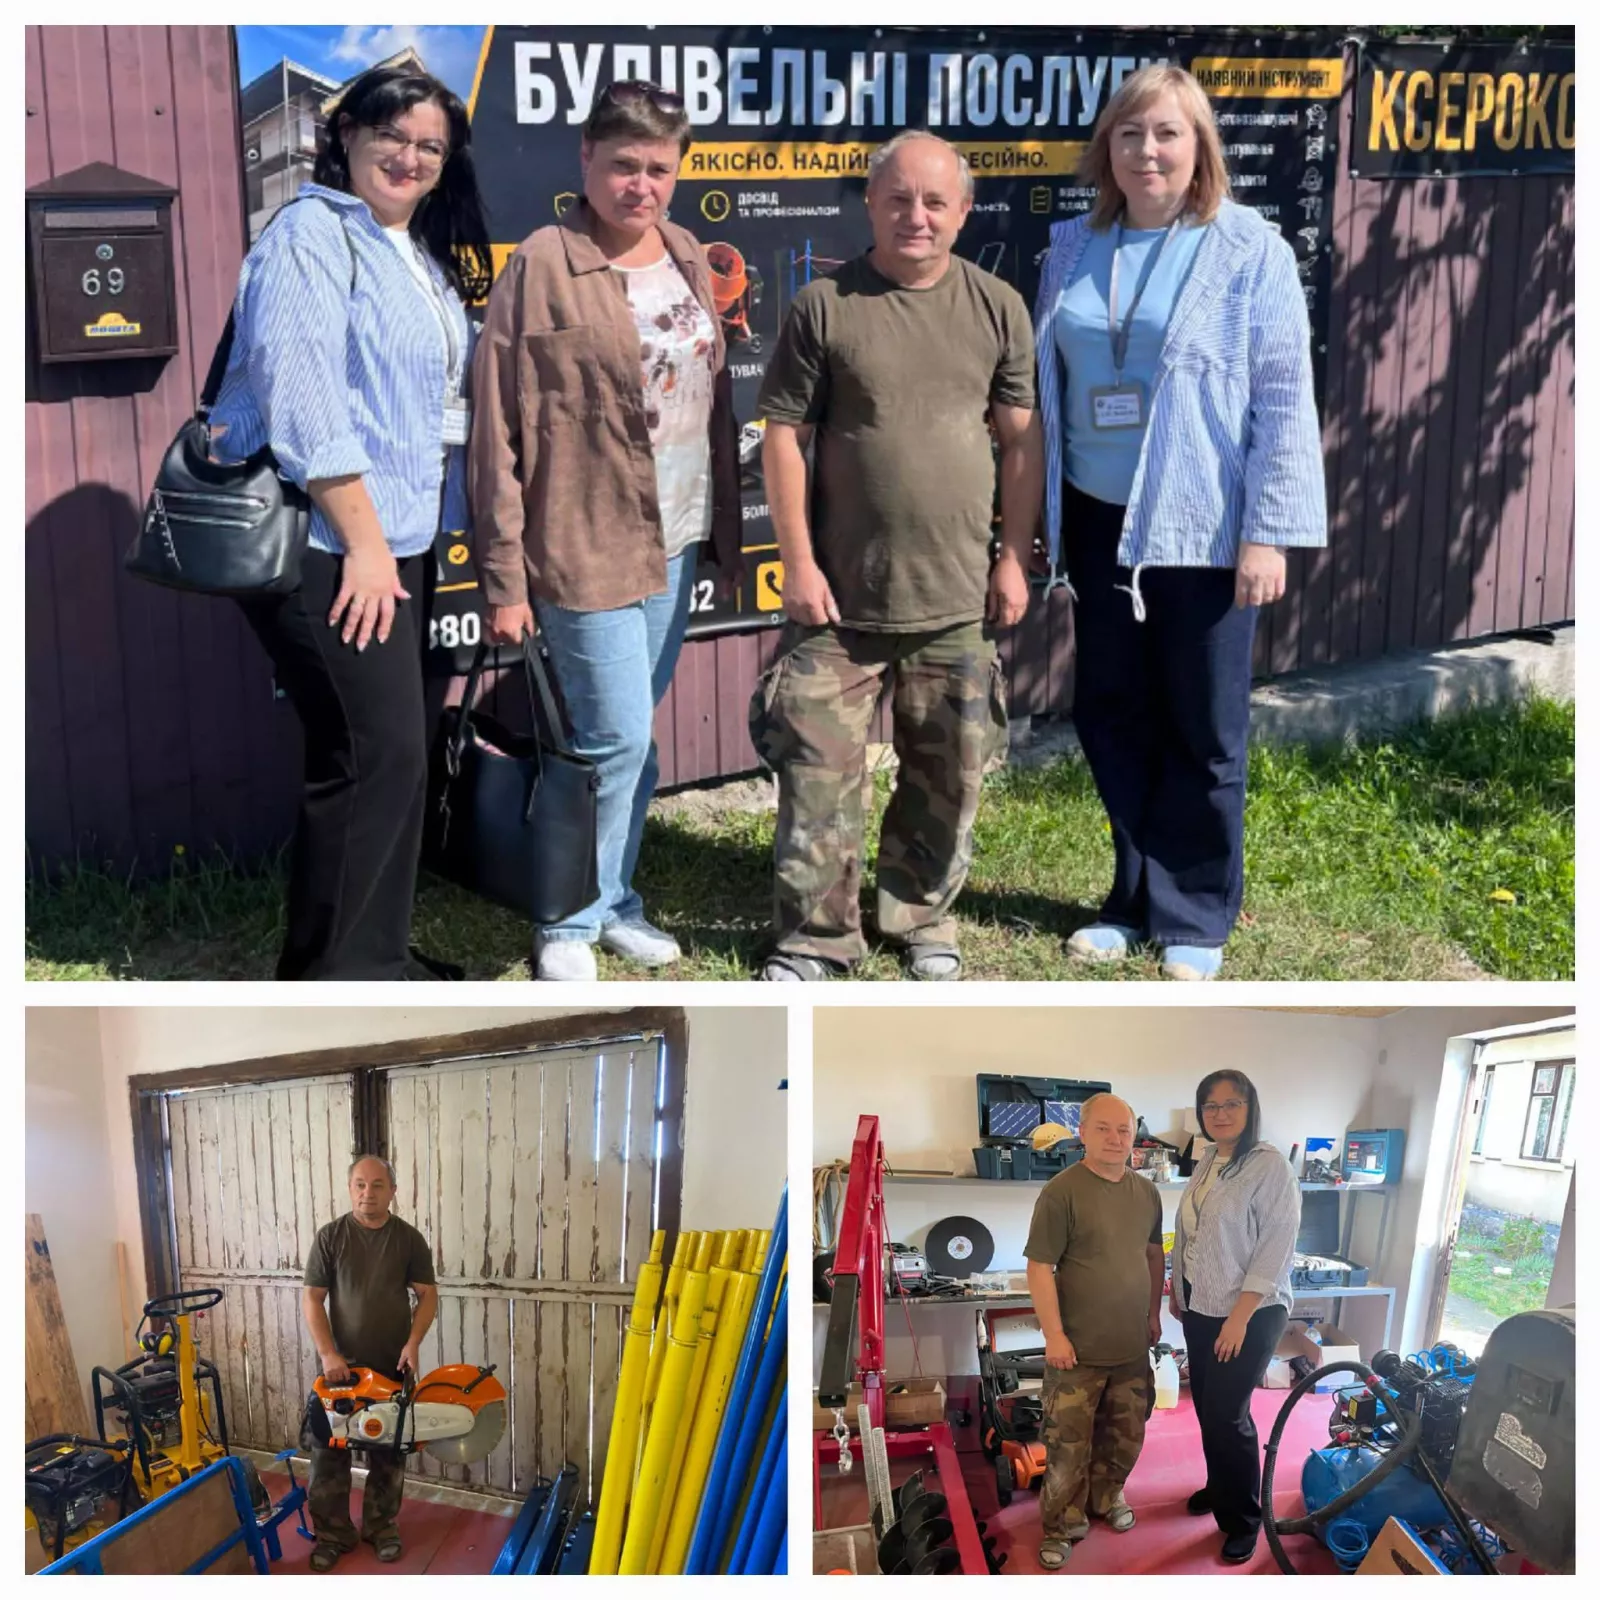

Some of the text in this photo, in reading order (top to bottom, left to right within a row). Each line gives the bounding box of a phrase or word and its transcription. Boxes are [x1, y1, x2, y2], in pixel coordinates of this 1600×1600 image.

[927, 53, 1169, 127] ПОСЛУГ
[1196, 67, 1331, 88] НАЯВНИЙ ІНСТРУМЕНТ
[691, 145, 1049, 173] ЯКІСНО. НАДІЙ ЕСІЙНО.
[738, 207, 750, 218] ТА
[81, 268, 125, 296] 69
